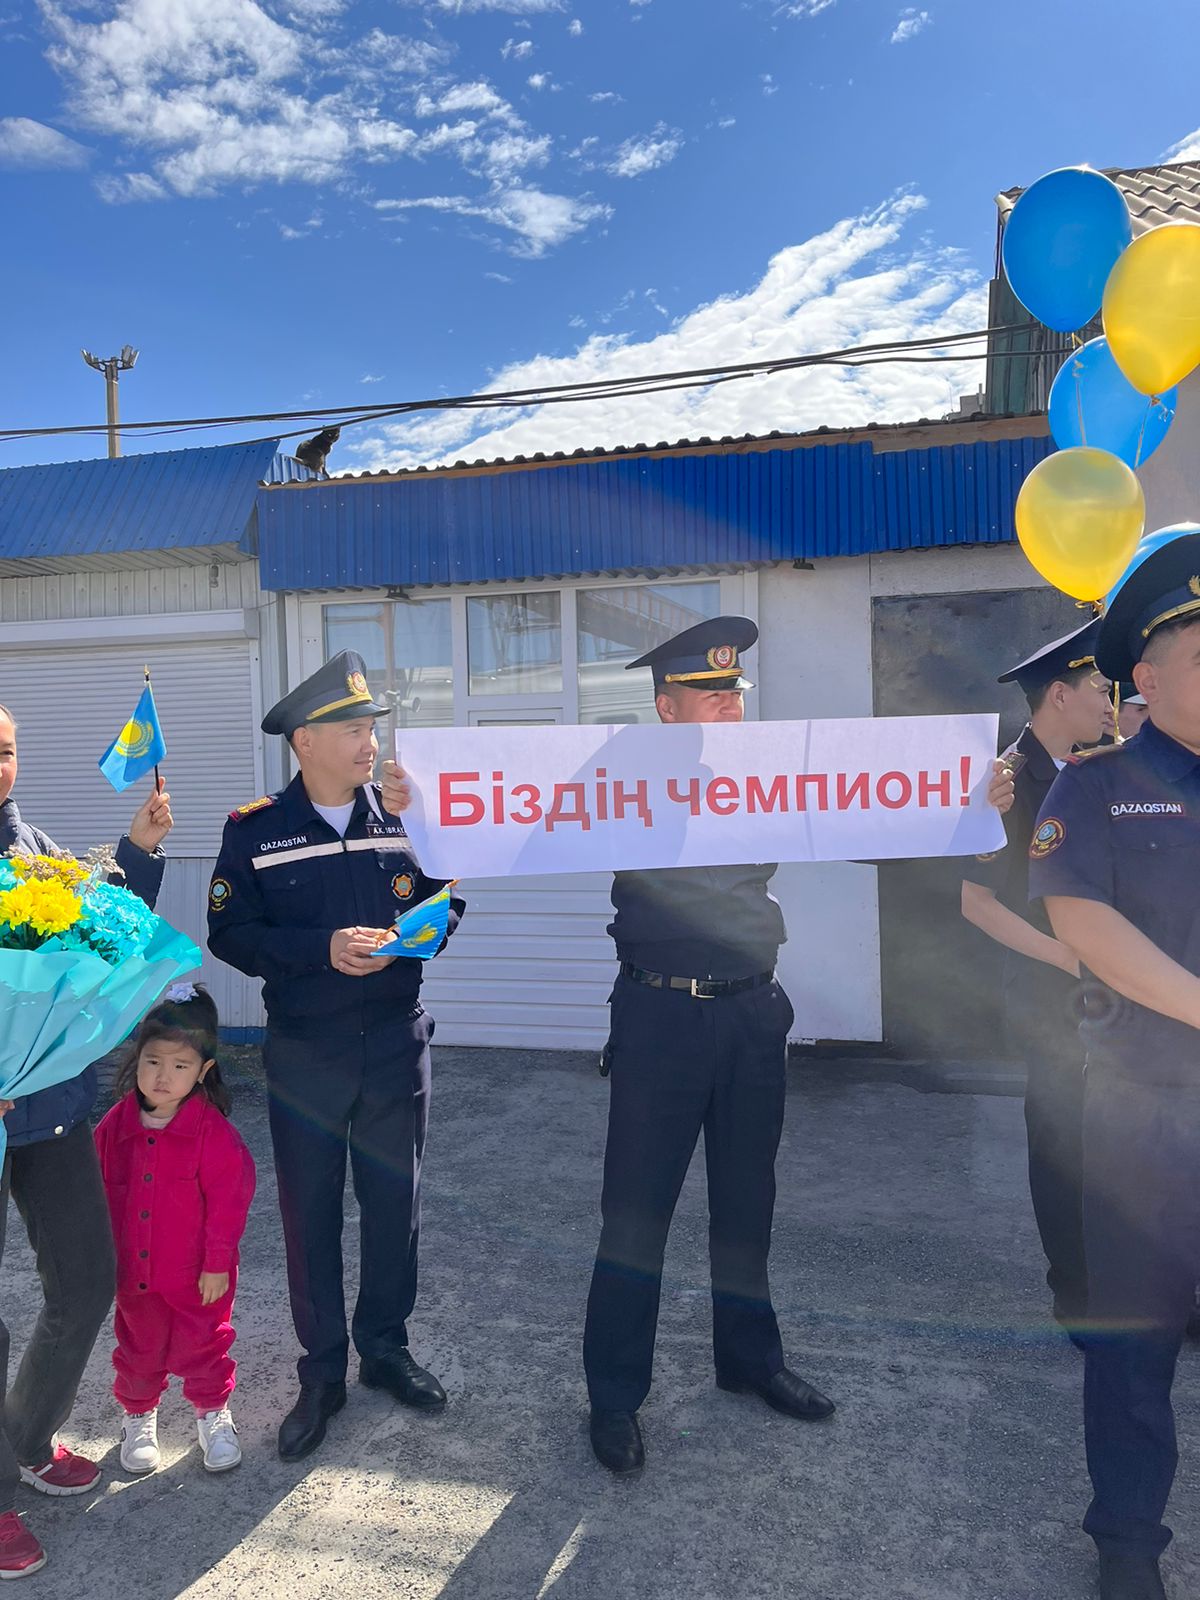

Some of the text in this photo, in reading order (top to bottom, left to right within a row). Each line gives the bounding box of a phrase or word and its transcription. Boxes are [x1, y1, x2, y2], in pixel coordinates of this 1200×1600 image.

[438, 756, 971, 832] Біздің чемпион!
[1111, 803, 1182, 816] QAZAQSTAN
[260, 835, 307, 851] QAZAQSTAN
